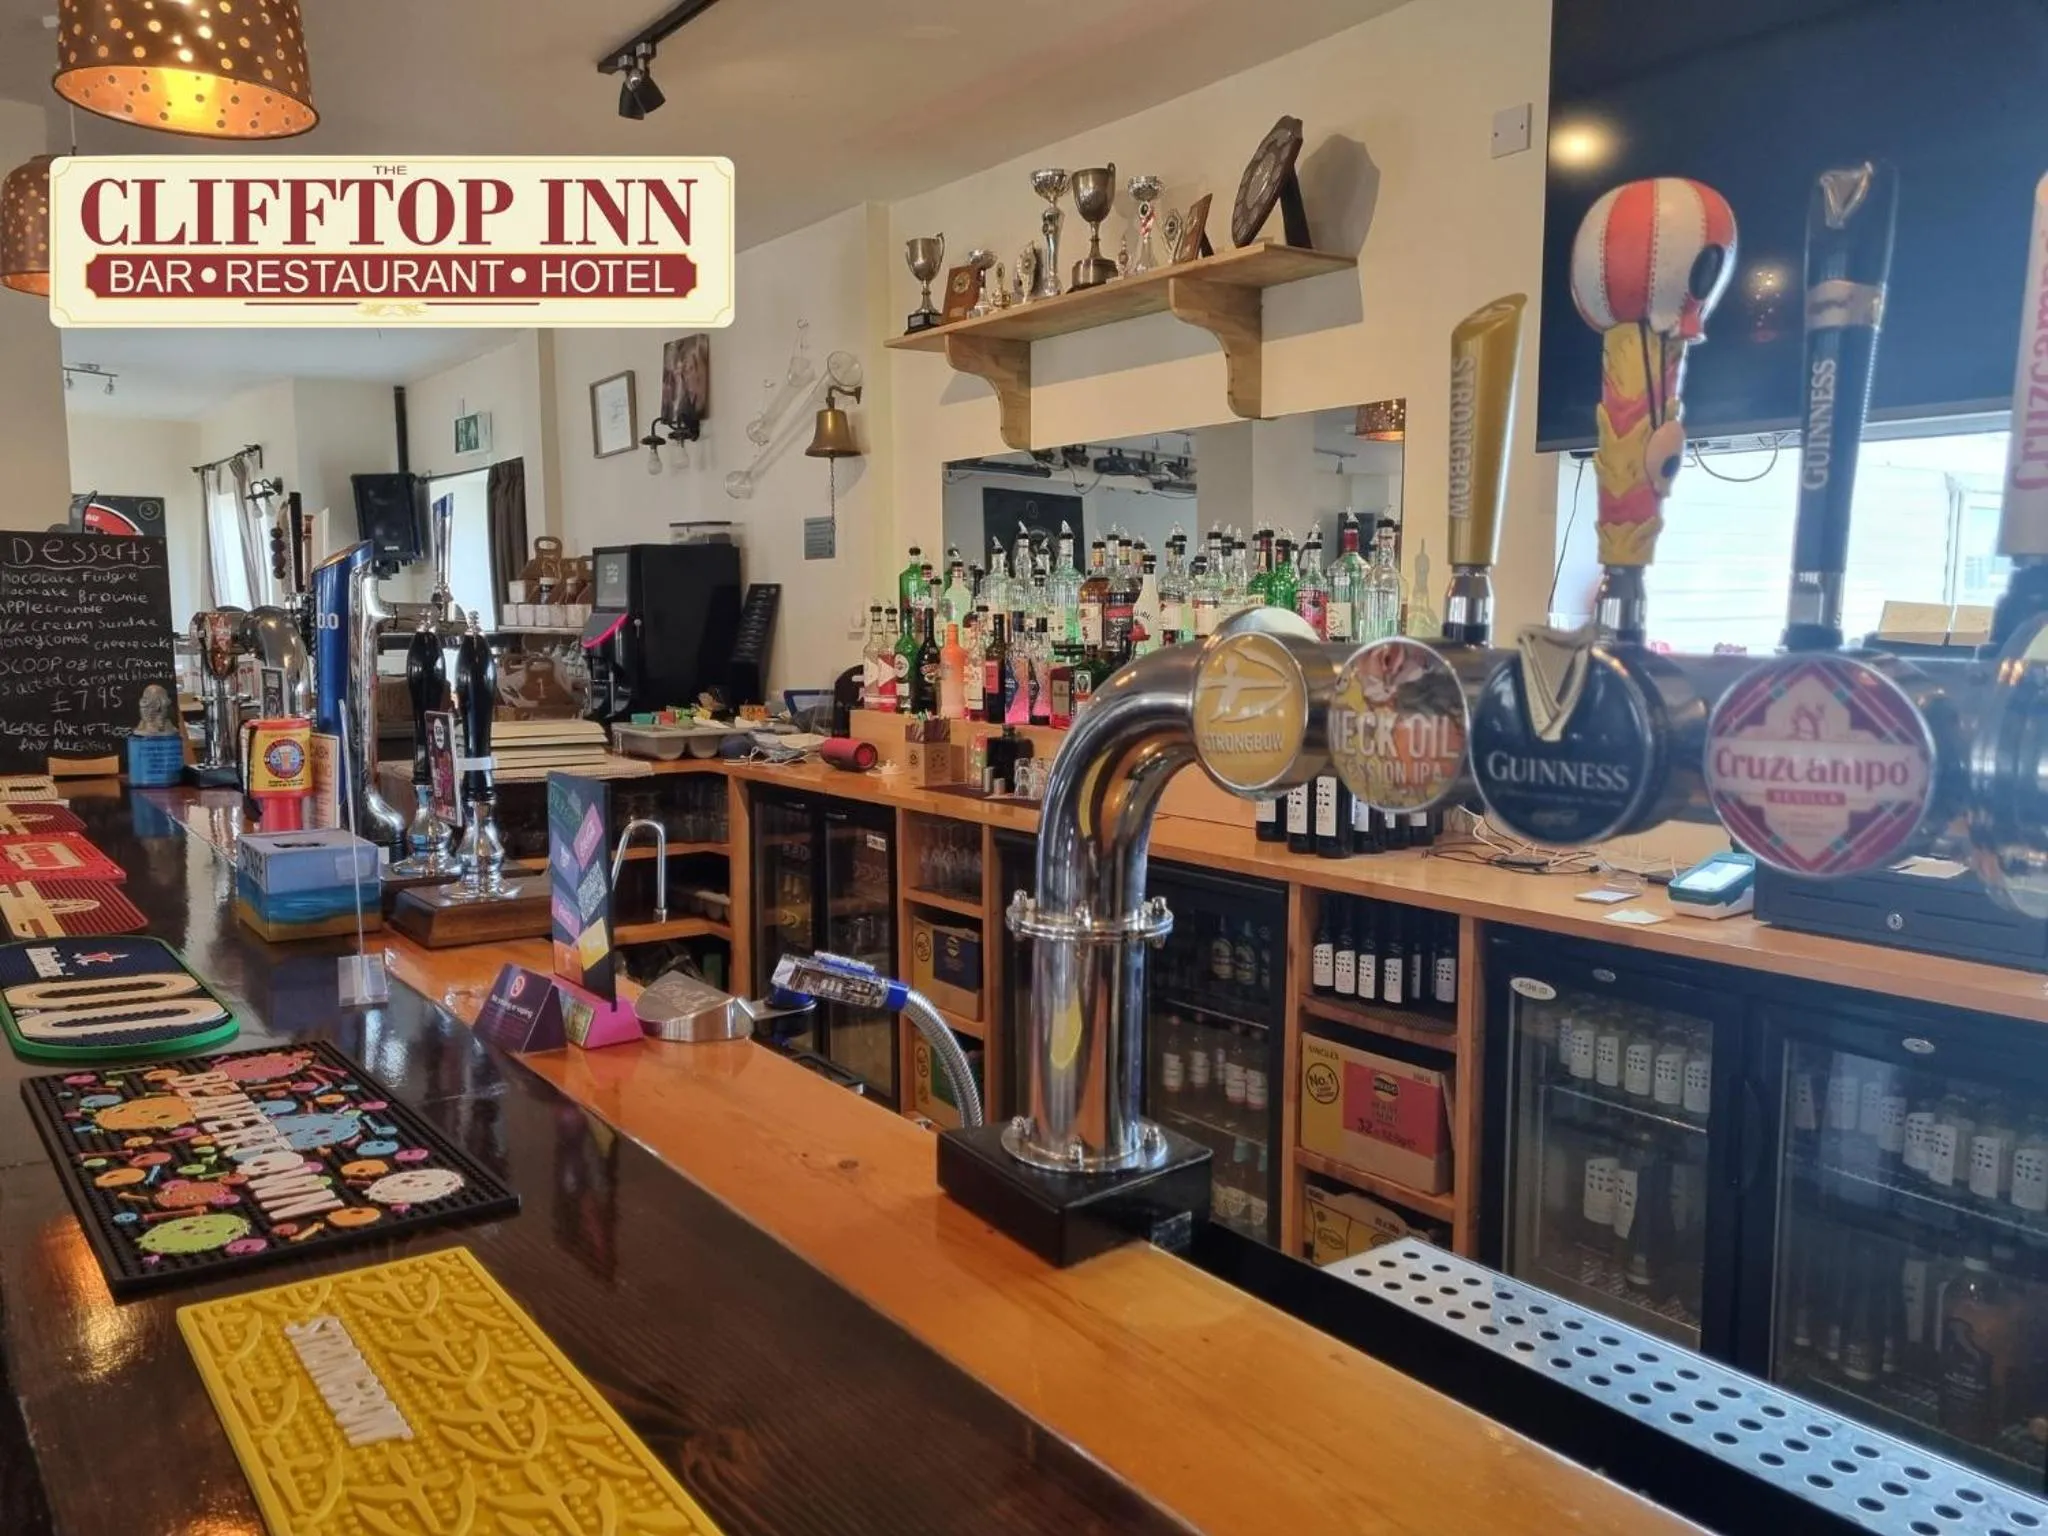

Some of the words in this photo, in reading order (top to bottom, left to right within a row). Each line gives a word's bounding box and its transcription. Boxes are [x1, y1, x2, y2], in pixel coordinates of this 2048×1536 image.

[2009, 237, 2048, 491] Cruzcam
[1448, 355, 1476, 520] STRONGBOW
[1802, 358, 1837, 490] GUINNESS
[1202, 731, 1283, 756] STRONGBOW
[1401, 711, 1460, 759] OIL
[1487, 750, 1630, 792] GUINNESS
[1715, 747, 1910, 792] Cruzcampo
